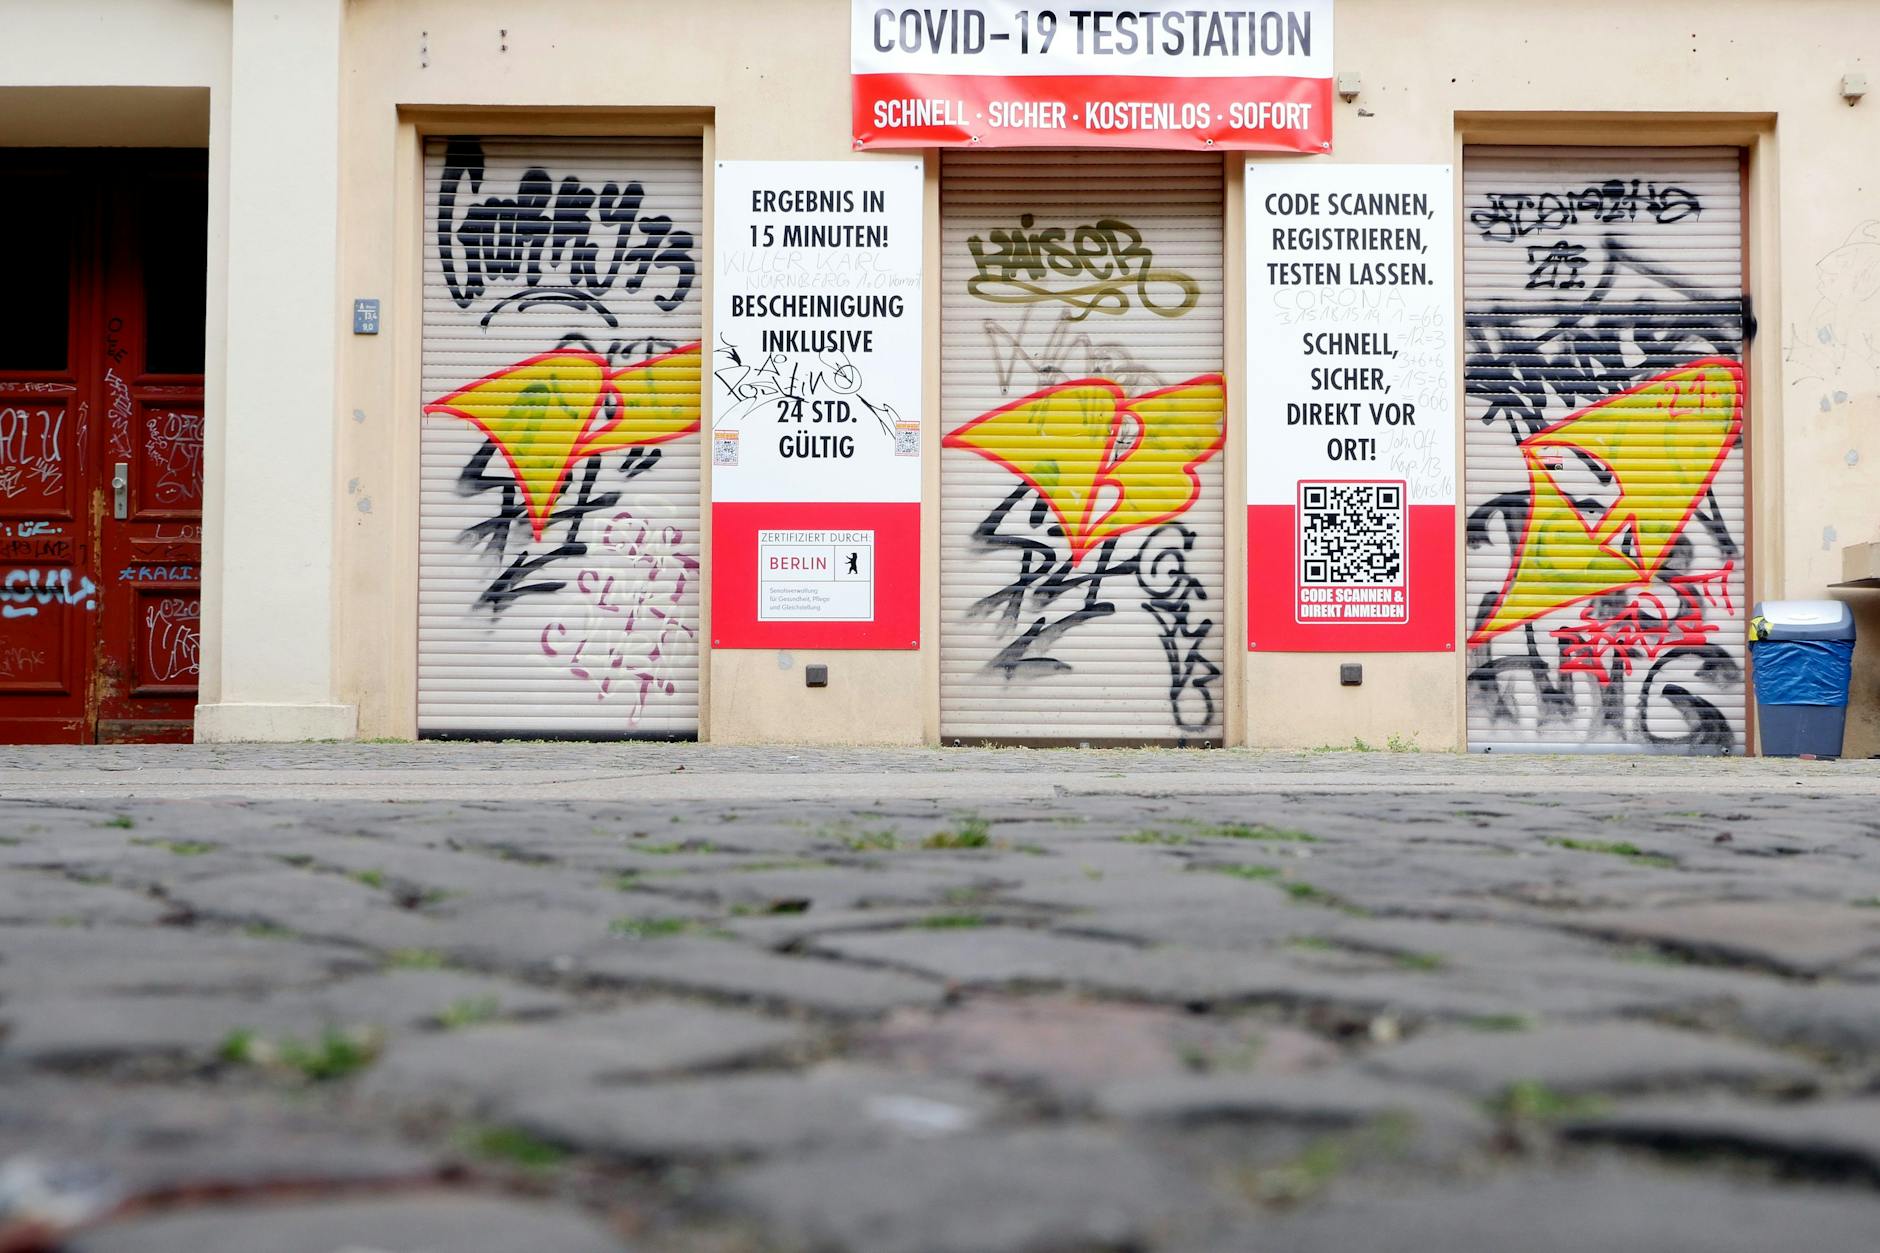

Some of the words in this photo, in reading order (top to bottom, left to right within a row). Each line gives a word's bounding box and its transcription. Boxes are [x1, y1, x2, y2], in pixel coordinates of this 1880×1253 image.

[873, 9, 1057, 54] COVID-19
[1069, 10, 1311, 57] TESTSTATION
[874, 99, 969, 128] SCHNELL
[988, 101, 1067, 129] SICHER
[1085, 102, 1211, 130] KOSTENLOS
[1229, 102, 1312, 130] SOFORT
[752, 190, 855, 213] ERGEBNIS
[863, 190, 885, 213] IN
[1265, 193, 1320, 216] CODE
[1328, 193, 1434, 220] SCANNEN,
[750, 225, 774, 248] 15
[782, 225, 888, 248] MINUTEN!
[1272, 228, 1428, 255] REGISTRIEREN,
[1267, 263, 1341, 286] TESTEN
[1350, 263, 1434, 286] LASSEN.
[732, 294, 904, 318] BESCHEINIGUNG
[1273, 287, 1406, 310] CORONA
[762, 330, 873, 353] INKLUSIVE
[1303, 333, 1399, 360] SCHNELL,
[1311, 368, 1391, 395] SICHER,
[777, 400, 804, 423] 24
[812, 400, 858, 423] STD.
[1287, 403, 1361, 426] DIREKT
[1369, 403, 1416, 426] VOR
[779, 430, 855, 459] GÜLTIG
[1327, 438, 1376, 461] ORT!
[761, 532, 826, 543] ZERTIFIZIERT
[769, 556, 827, 570] BERLIN
[1300, 588, 1334, 603] CODE
[1335, 588, 1392, 603] SCANNEN
[1393, 590, 1404, 603] &
[1300, 604, 1343, 618] DIREKT
[1344, 604, 1404, 618] ANMELDEN
